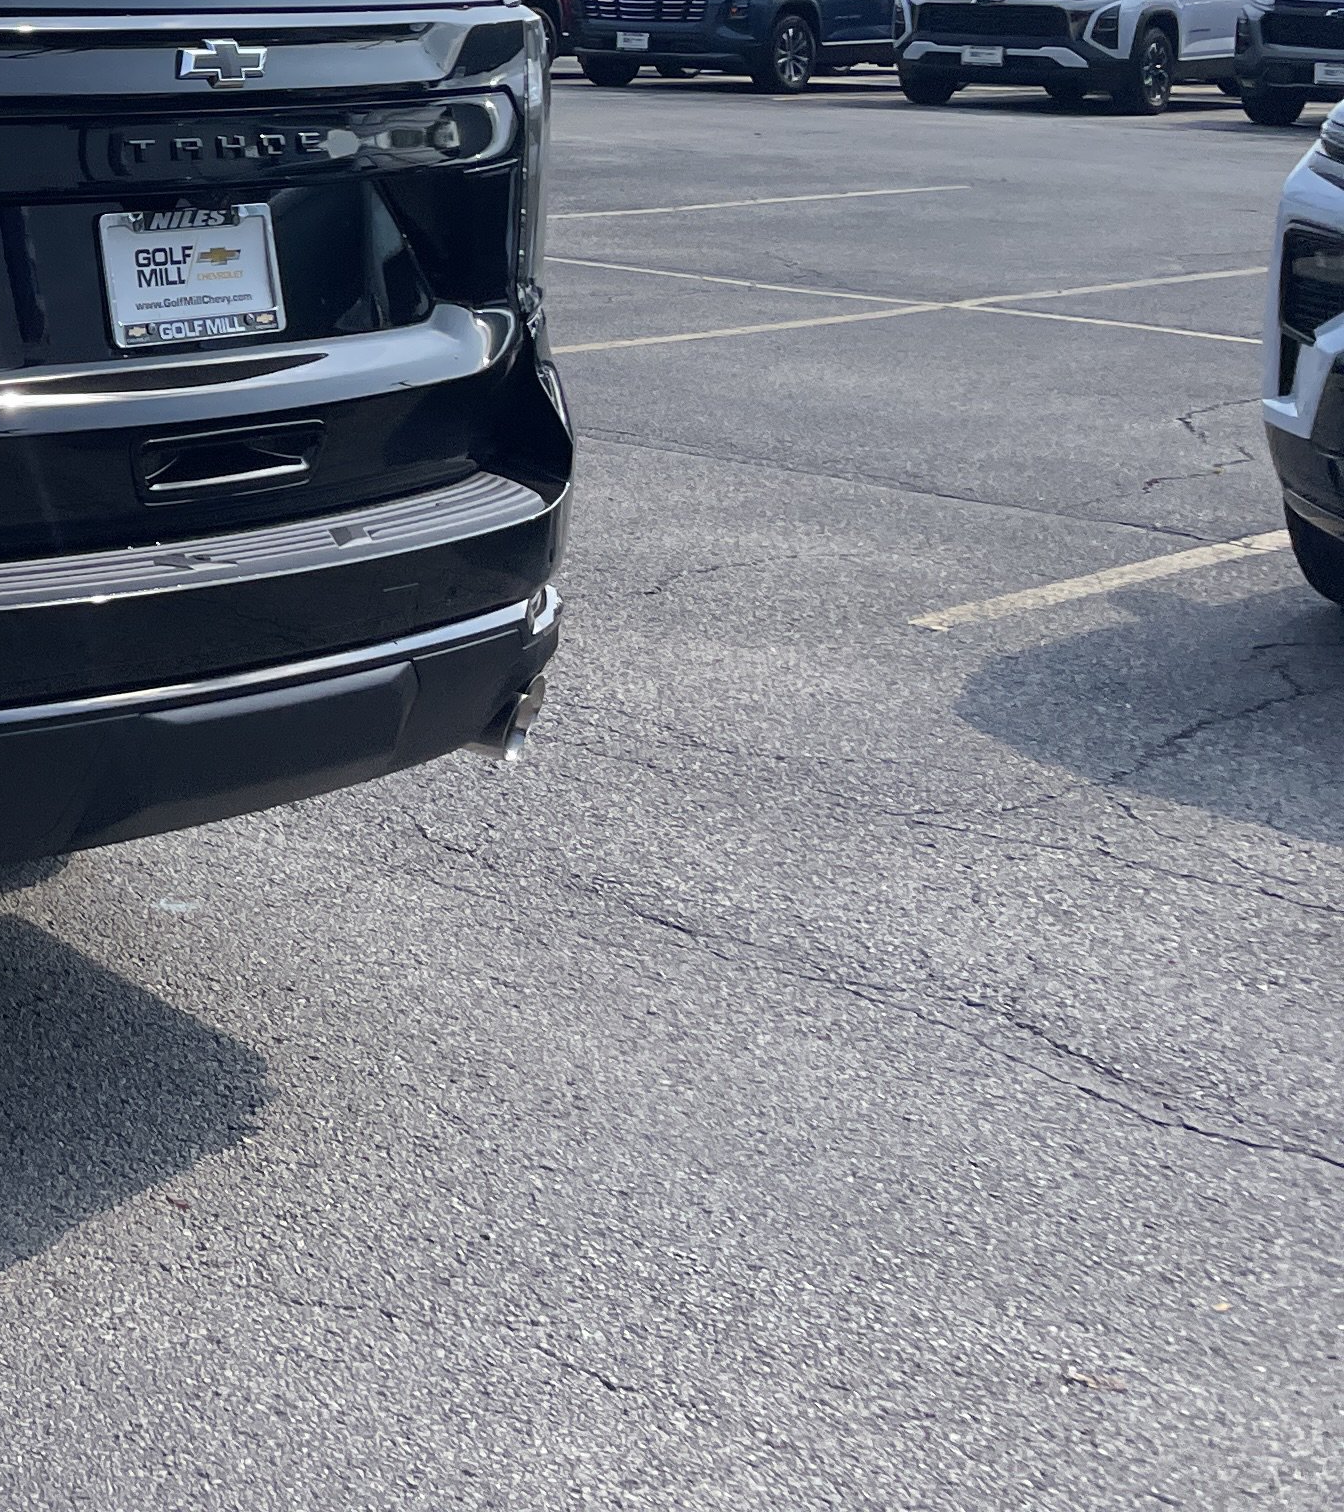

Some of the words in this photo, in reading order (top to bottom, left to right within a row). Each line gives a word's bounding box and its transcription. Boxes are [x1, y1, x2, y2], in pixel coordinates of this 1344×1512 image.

[126, 132, 326, 164] TAHOE
[149, 209, 227, 230] NILES
[135, 245, 193, 268] GOLF
[136, 267, 186, 288] MILL
[135, 293, 252, 311] www.GolfMillChevy.com
[159, 320, 204, 339] GOLF
[205, 316, 245, 335] MILL
